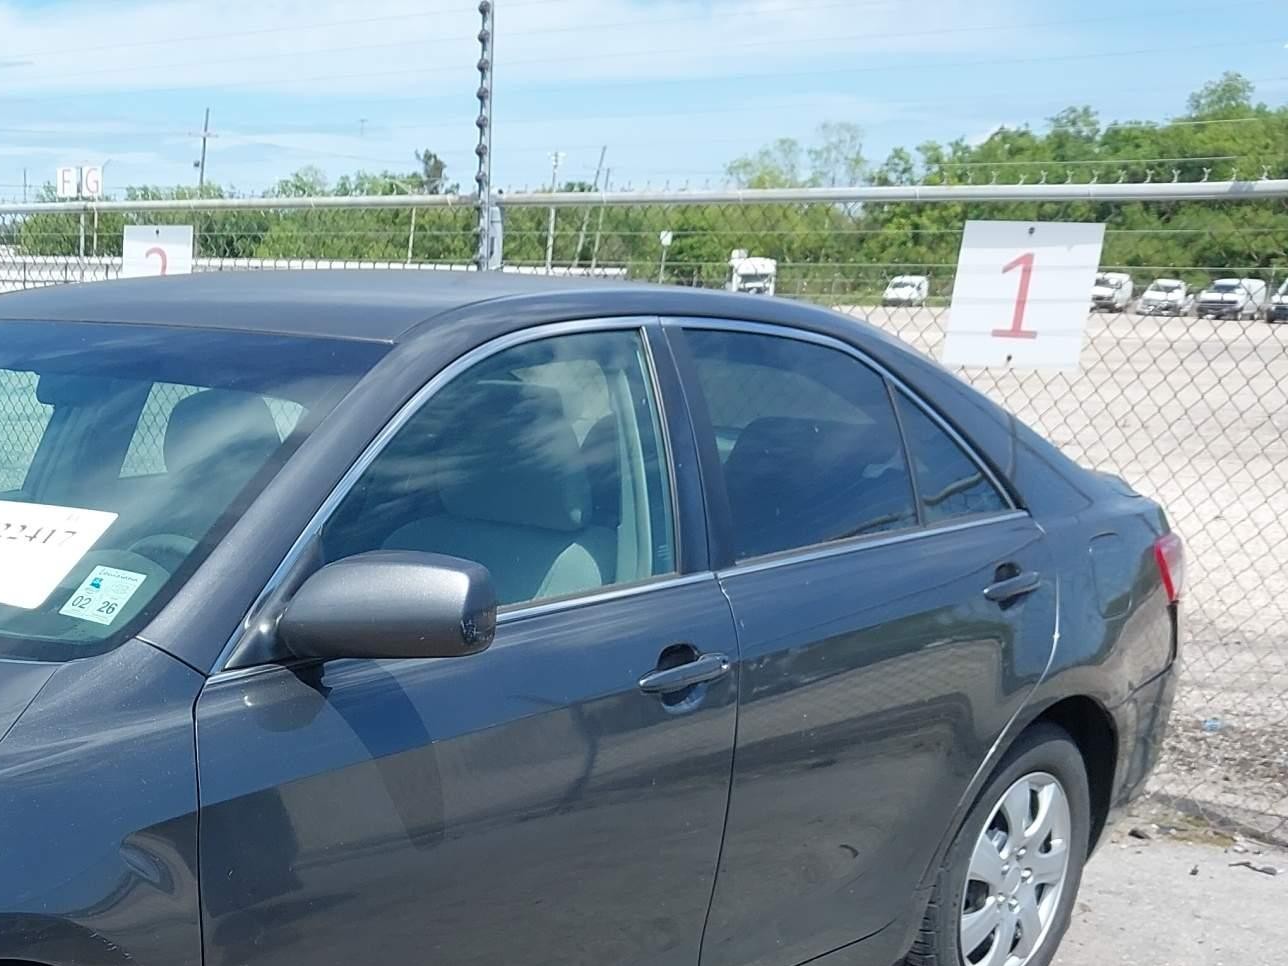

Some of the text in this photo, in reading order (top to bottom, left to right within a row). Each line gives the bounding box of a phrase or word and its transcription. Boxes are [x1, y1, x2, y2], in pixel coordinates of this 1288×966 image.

[61, 169, 72, 197] F
[85, 167, 99, 193] G
[991, 252, 1038, 339] 1
[72, 595, 91, 609] 02
[96, 600, 118, 614] 26
